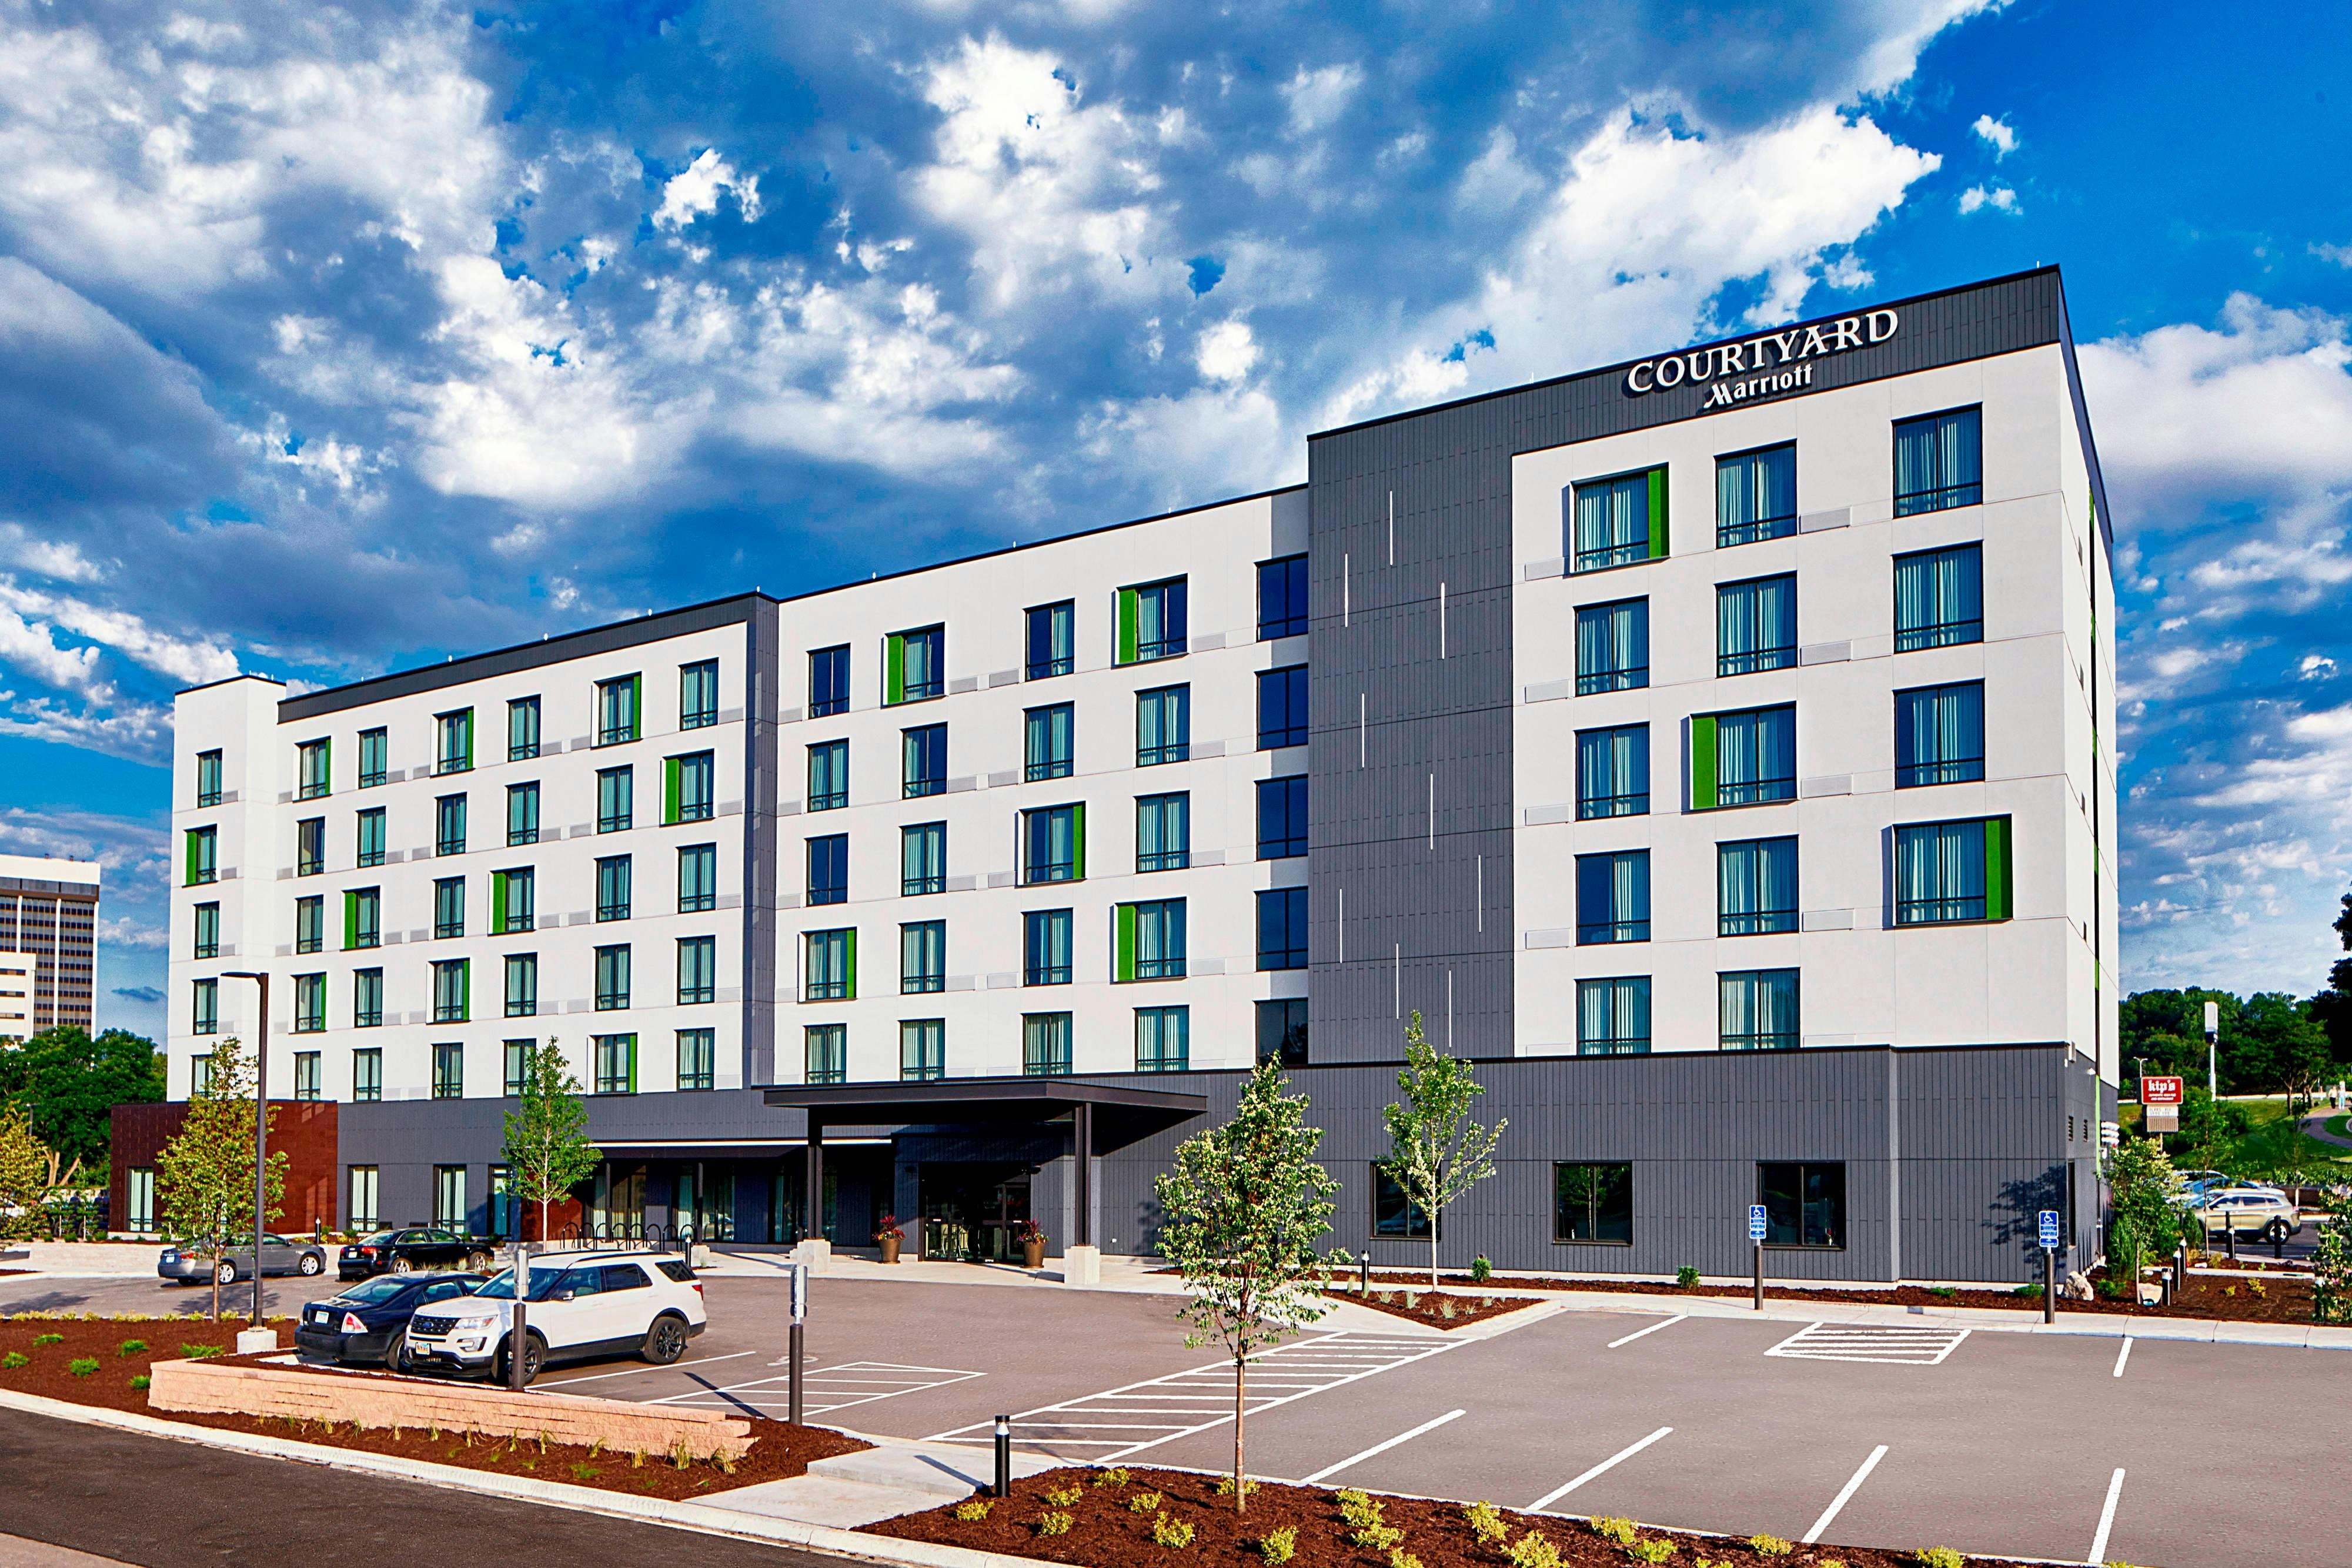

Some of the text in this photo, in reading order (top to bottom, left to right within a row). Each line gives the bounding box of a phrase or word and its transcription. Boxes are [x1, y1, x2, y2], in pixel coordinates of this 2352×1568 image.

[1628, 309, 1899, 393] COURTYARD
[1703, 363, 1813, 409] Marriott
[2147, 1079, 2176, 1094] kip's
